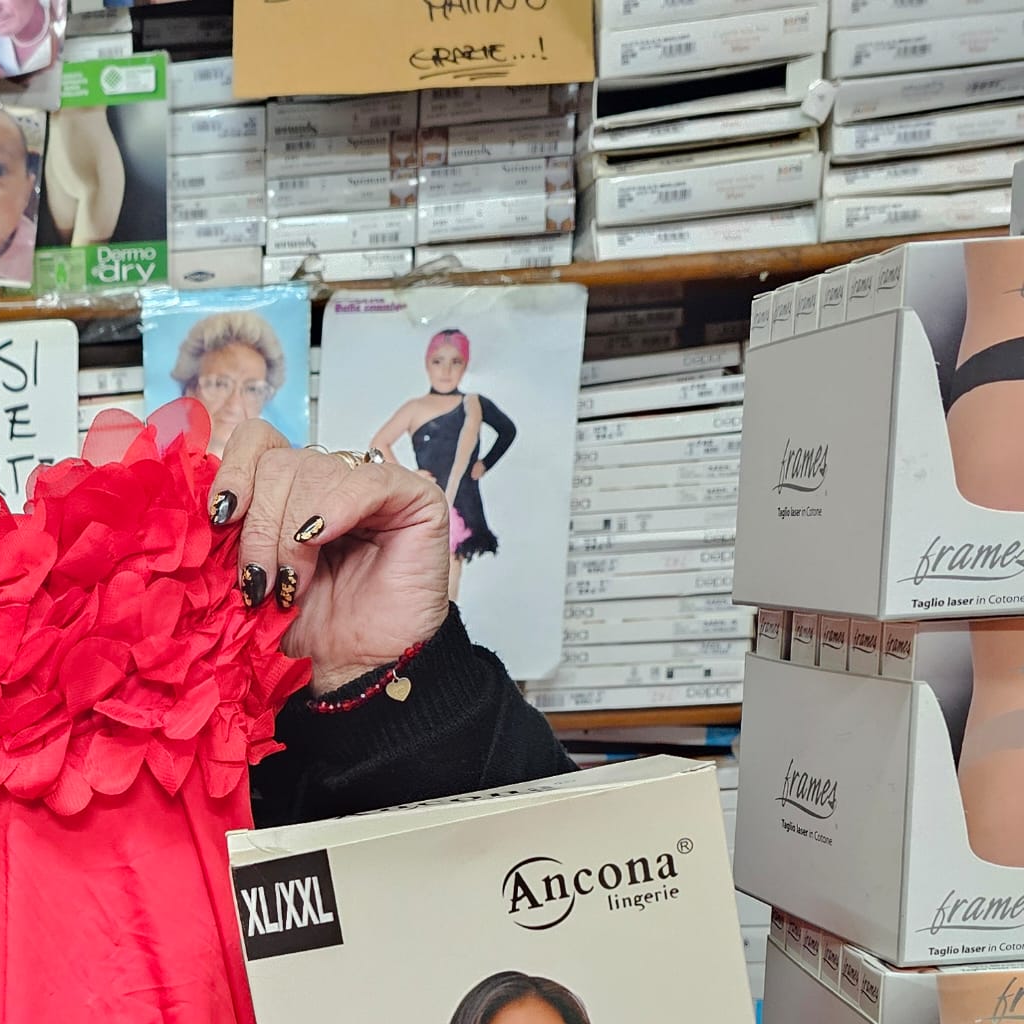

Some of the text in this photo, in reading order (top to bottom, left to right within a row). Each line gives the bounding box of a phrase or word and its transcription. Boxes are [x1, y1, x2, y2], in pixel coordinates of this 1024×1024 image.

[97, 246, 156, 263] Dermo
[98, 261, 156, 284] dry
[911, 597, 945, 609] Taglio
[947, 597, 974, 607] laser
[976, 595, 986, 605] in
[775, 758, 838, 820] frames
[240, 876, 334, 938] XL/XXL
[607, 886, 680, 911] lingerie
[929, 946, 960, 957] Taglio
[962, 944, 986, 954] laser
[988, 943, 997, 952] in
